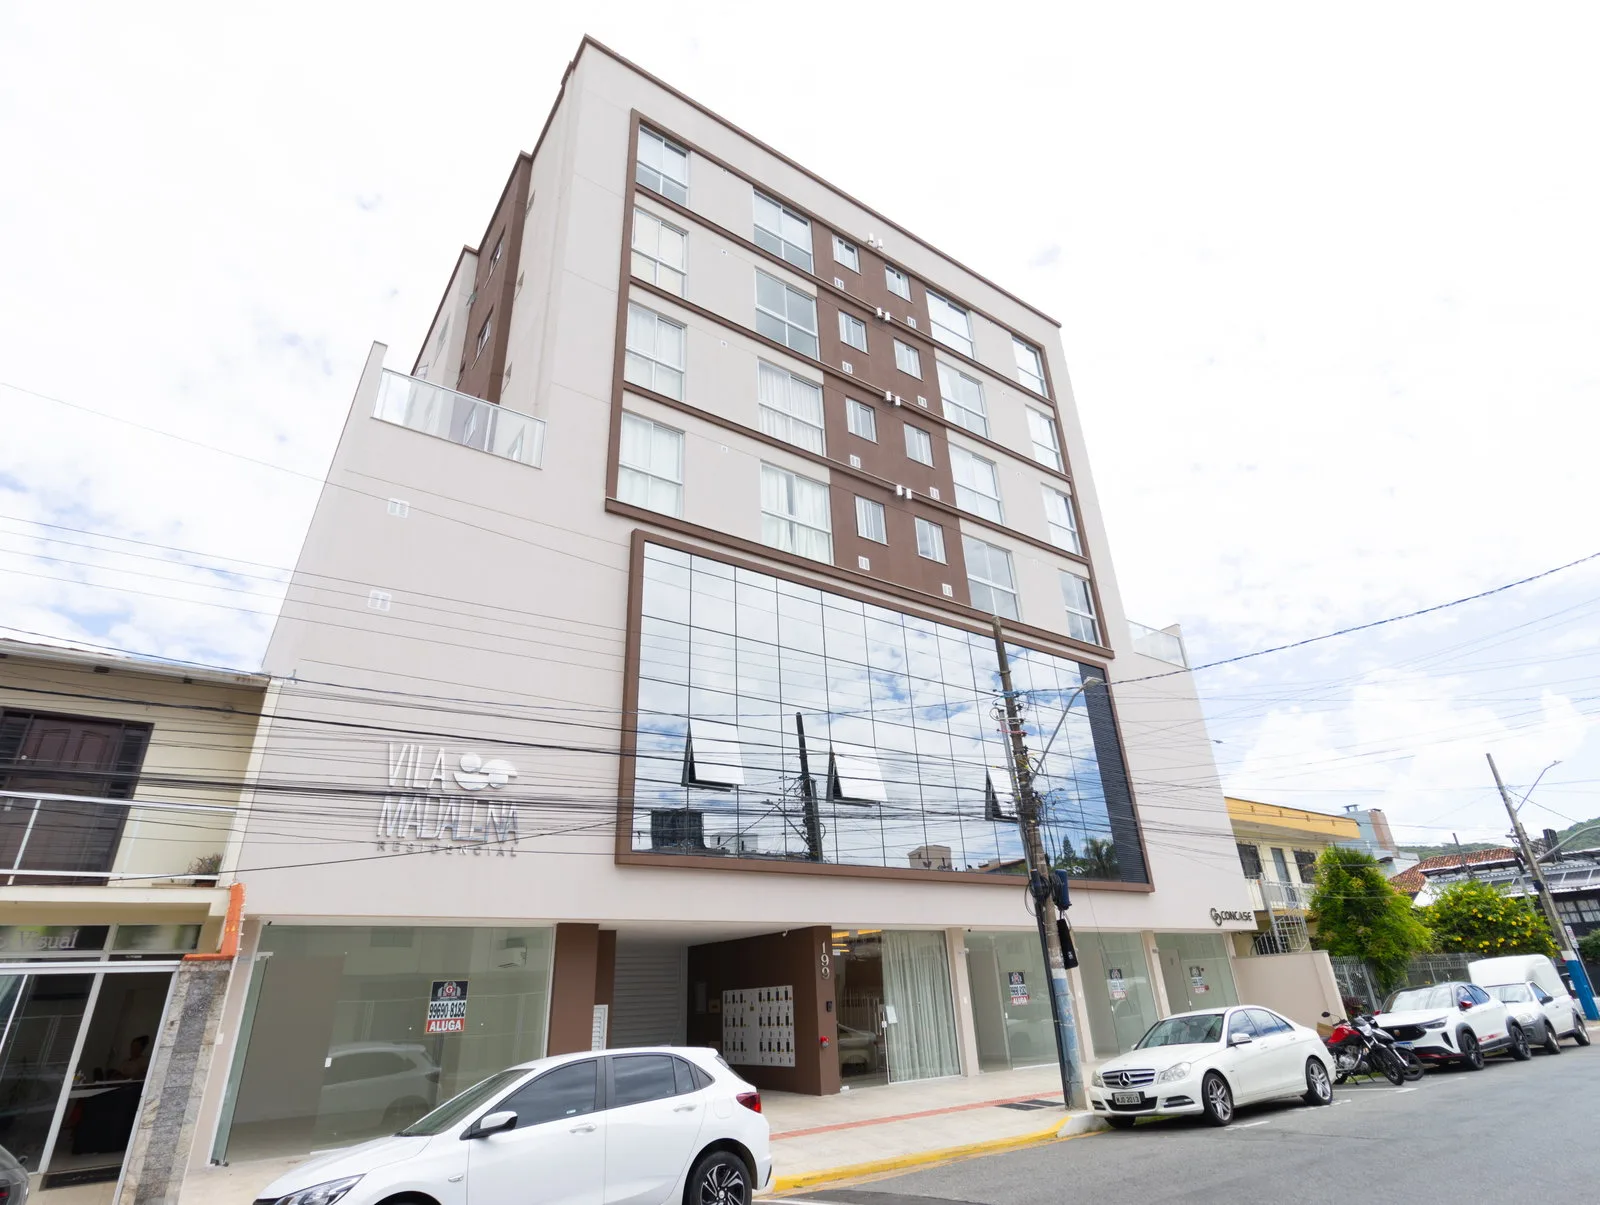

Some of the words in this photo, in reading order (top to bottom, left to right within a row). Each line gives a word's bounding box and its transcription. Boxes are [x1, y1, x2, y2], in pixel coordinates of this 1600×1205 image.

[388, 743, 446, 791] VILA
[1220, 910, 1252, 921] CONCASE
[17, 929, 80, 950] Vsual
[820, 940, 830, 980] 199
[429, 1019, 462, 1032] ALUGA
